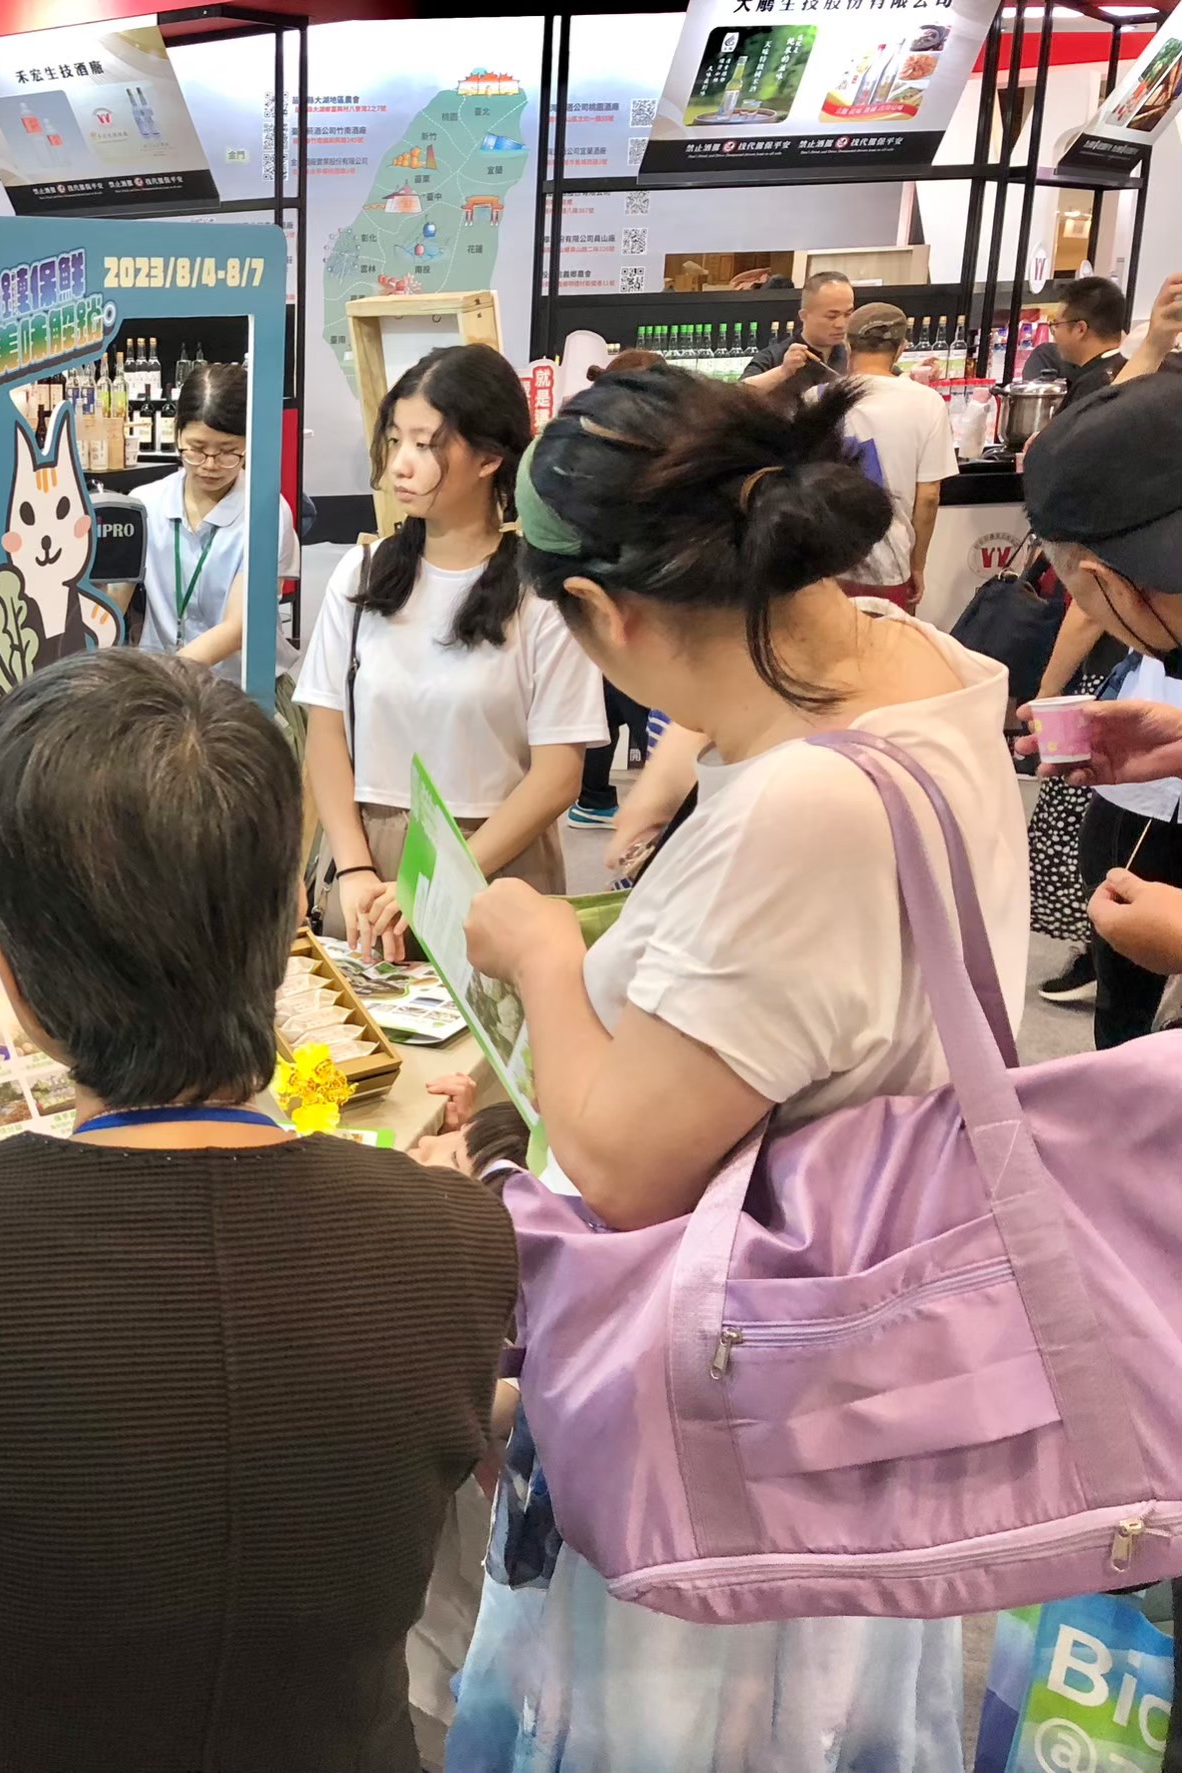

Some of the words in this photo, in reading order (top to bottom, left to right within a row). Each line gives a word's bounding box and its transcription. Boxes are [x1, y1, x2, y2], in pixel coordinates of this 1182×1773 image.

[15, 60, 105, 84] 禾宏生技酒廠
[292, 95, 360, 104] 苗縣大湖地區農會
[474, 107, 490, 116] 臺北
[441, 113, 458, 121] 桃園
[291, 126, 367, 135] 臺菸酒公司竹南酒廠
[421, 132, 437, 141] 新竹
[291, 157, 369, 166] 金酒廠實業股份有限公司
[487, 166, 503, 175] 宜蘭
[414, 175, 430, 183] 苗栗
[426, 193, 442, 201] 臺中
[361, 234, 377, 243] 彰化
[467, 244, 483, 254] 花蓮
[104, 256, 265, 288] 2023/8/4-8/7
[360, 265, 376, 273] 雲林
[97, 523, 135, 538] IPRO
